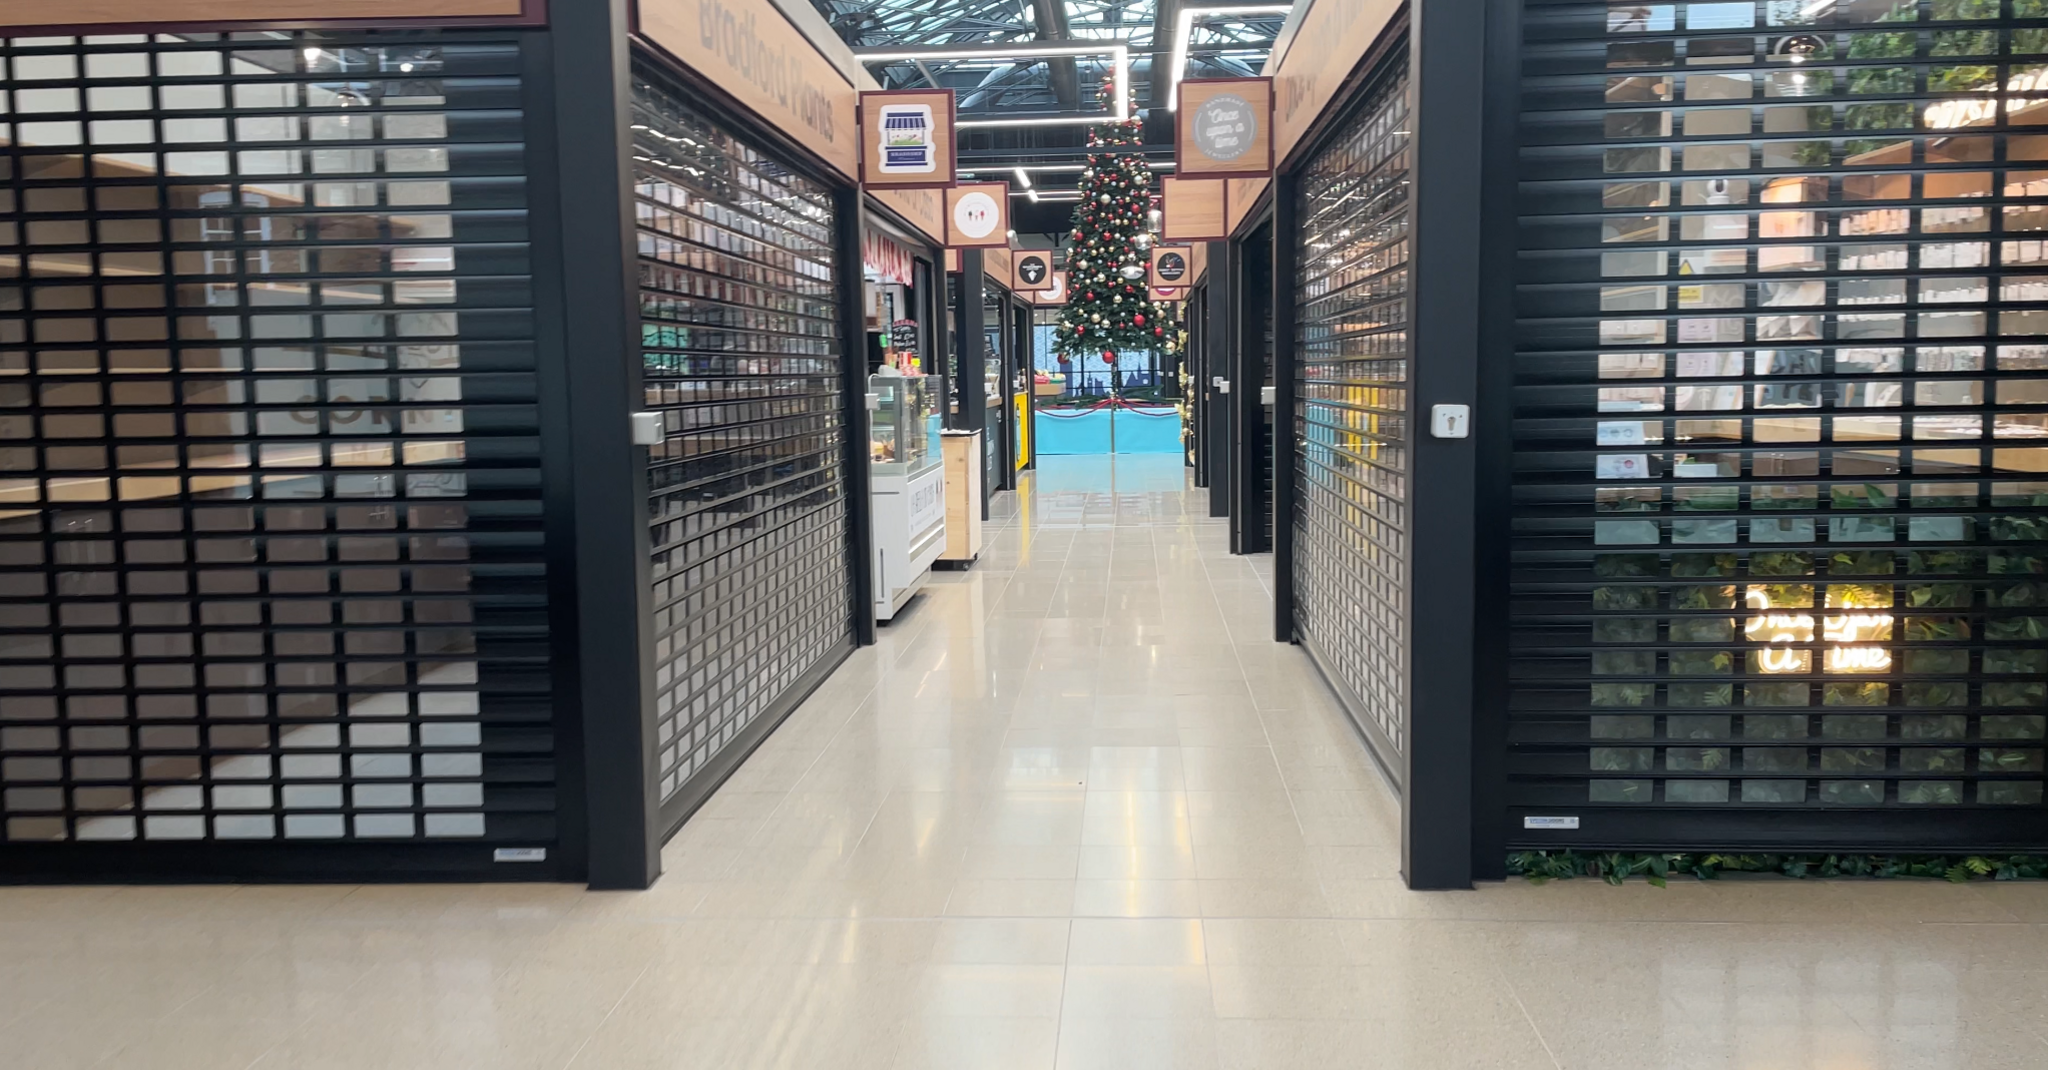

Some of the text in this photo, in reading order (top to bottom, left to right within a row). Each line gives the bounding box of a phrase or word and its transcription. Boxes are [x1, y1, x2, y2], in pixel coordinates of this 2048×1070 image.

[1207, 108, 1239, 123] Once
[1206, 122, 1245, 139] upon a
